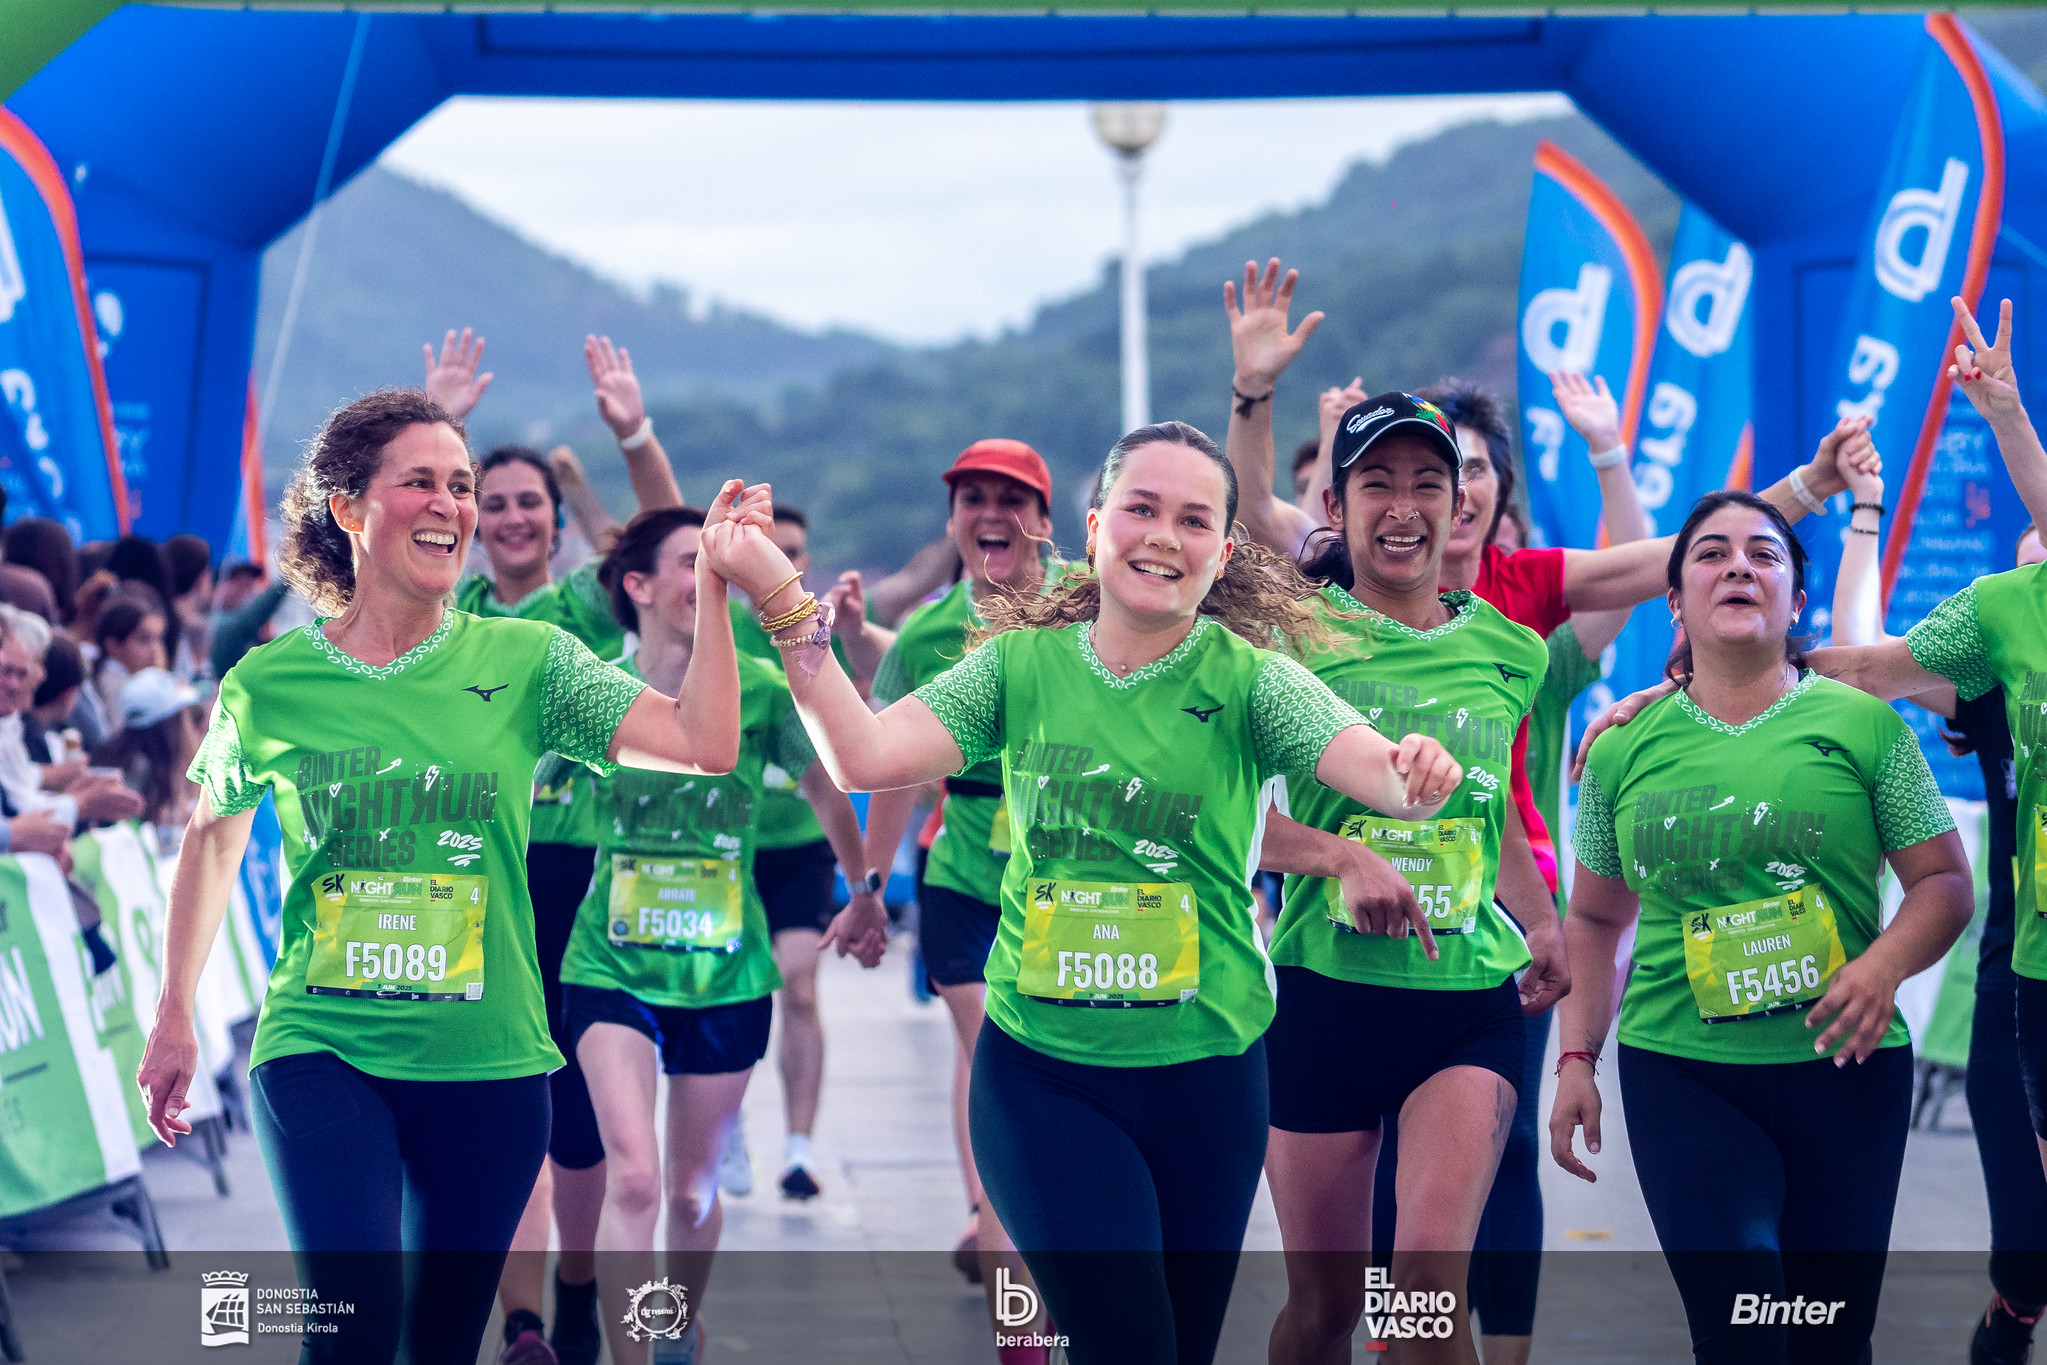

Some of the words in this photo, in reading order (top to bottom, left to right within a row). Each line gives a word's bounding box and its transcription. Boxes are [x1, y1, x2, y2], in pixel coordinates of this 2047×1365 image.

[297, 746, 382, 791] BINTER
[1466, 766, 1500, 790] 2025
[437, 830, 483, 850] 2025
[1346, 819, 1367, 840] 5K
[1470, 829, 1477, 845] 4
[327, 830, 416, 868] SERIES
[1133, 839, 1178, 860] 2025
[1391, 857, 1433, 872] WENDY
[1764, 861, 1807, 878] 2025
[321, 873, 345, 897] 5K
[1034, 882, 1056, 905] 5K
[470, 887, 479, 905] 4
[1180, 894, 1190, 912] 4
[1815, 894, 1825, 910] 4
[378, 914, 417, 931] IRENE
[638, 907, 713, 938] F5034
[1093, 923, 1120, 940] ANA
[1691, 912, 1712, 934] 5K
[1742, 934, 1792, 957] LAUREN
[345, 941, 447, 982] F5089
[1057, 951, 1159, 989] F5088
[1726, 955, 1820, 1005] F5456
